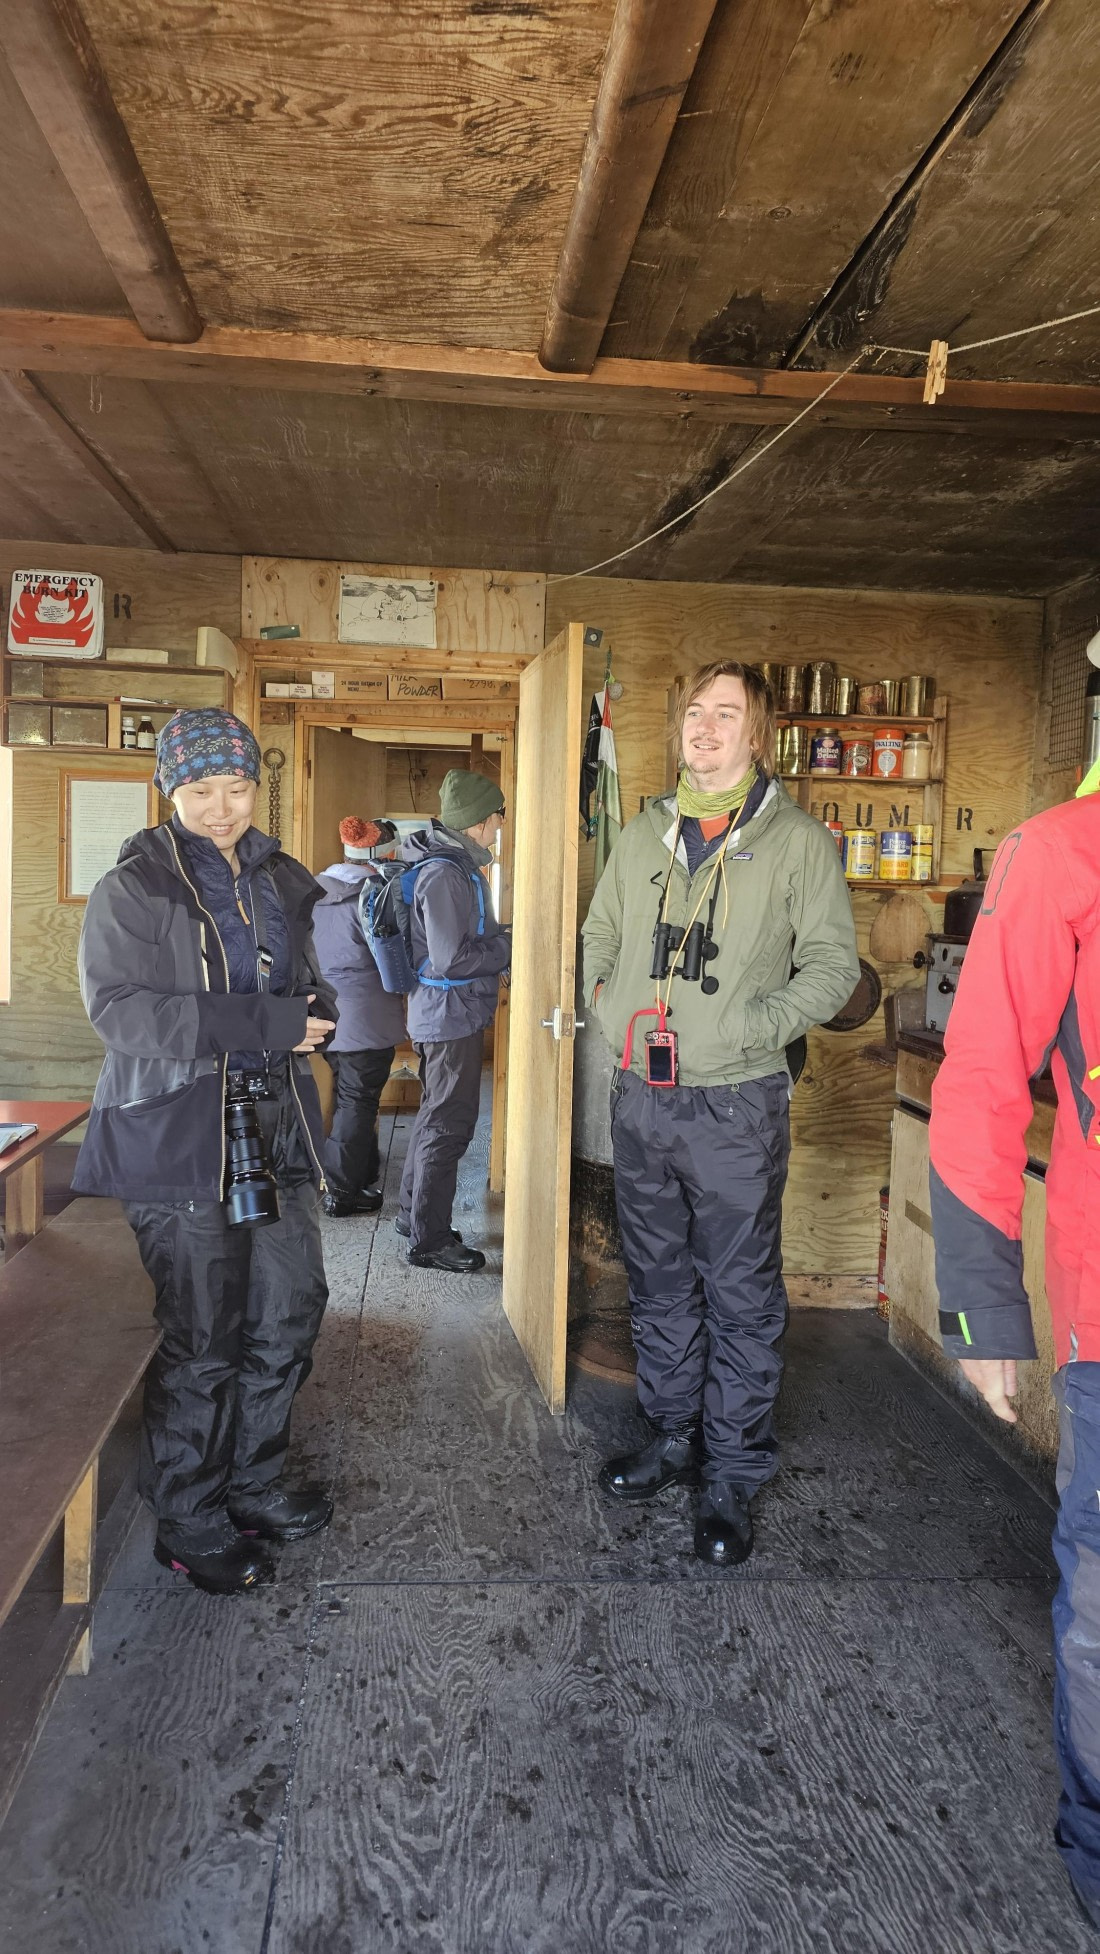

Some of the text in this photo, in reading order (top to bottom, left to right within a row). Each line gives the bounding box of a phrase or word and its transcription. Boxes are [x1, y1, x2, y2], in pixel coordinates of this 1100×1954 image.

[15, 573, 97, 587] EMERGENCY
[23, 585, 87, 598] BURN KIT
[113, 593, 132, 619] R
[397, 682, 439, 697] POWDER
